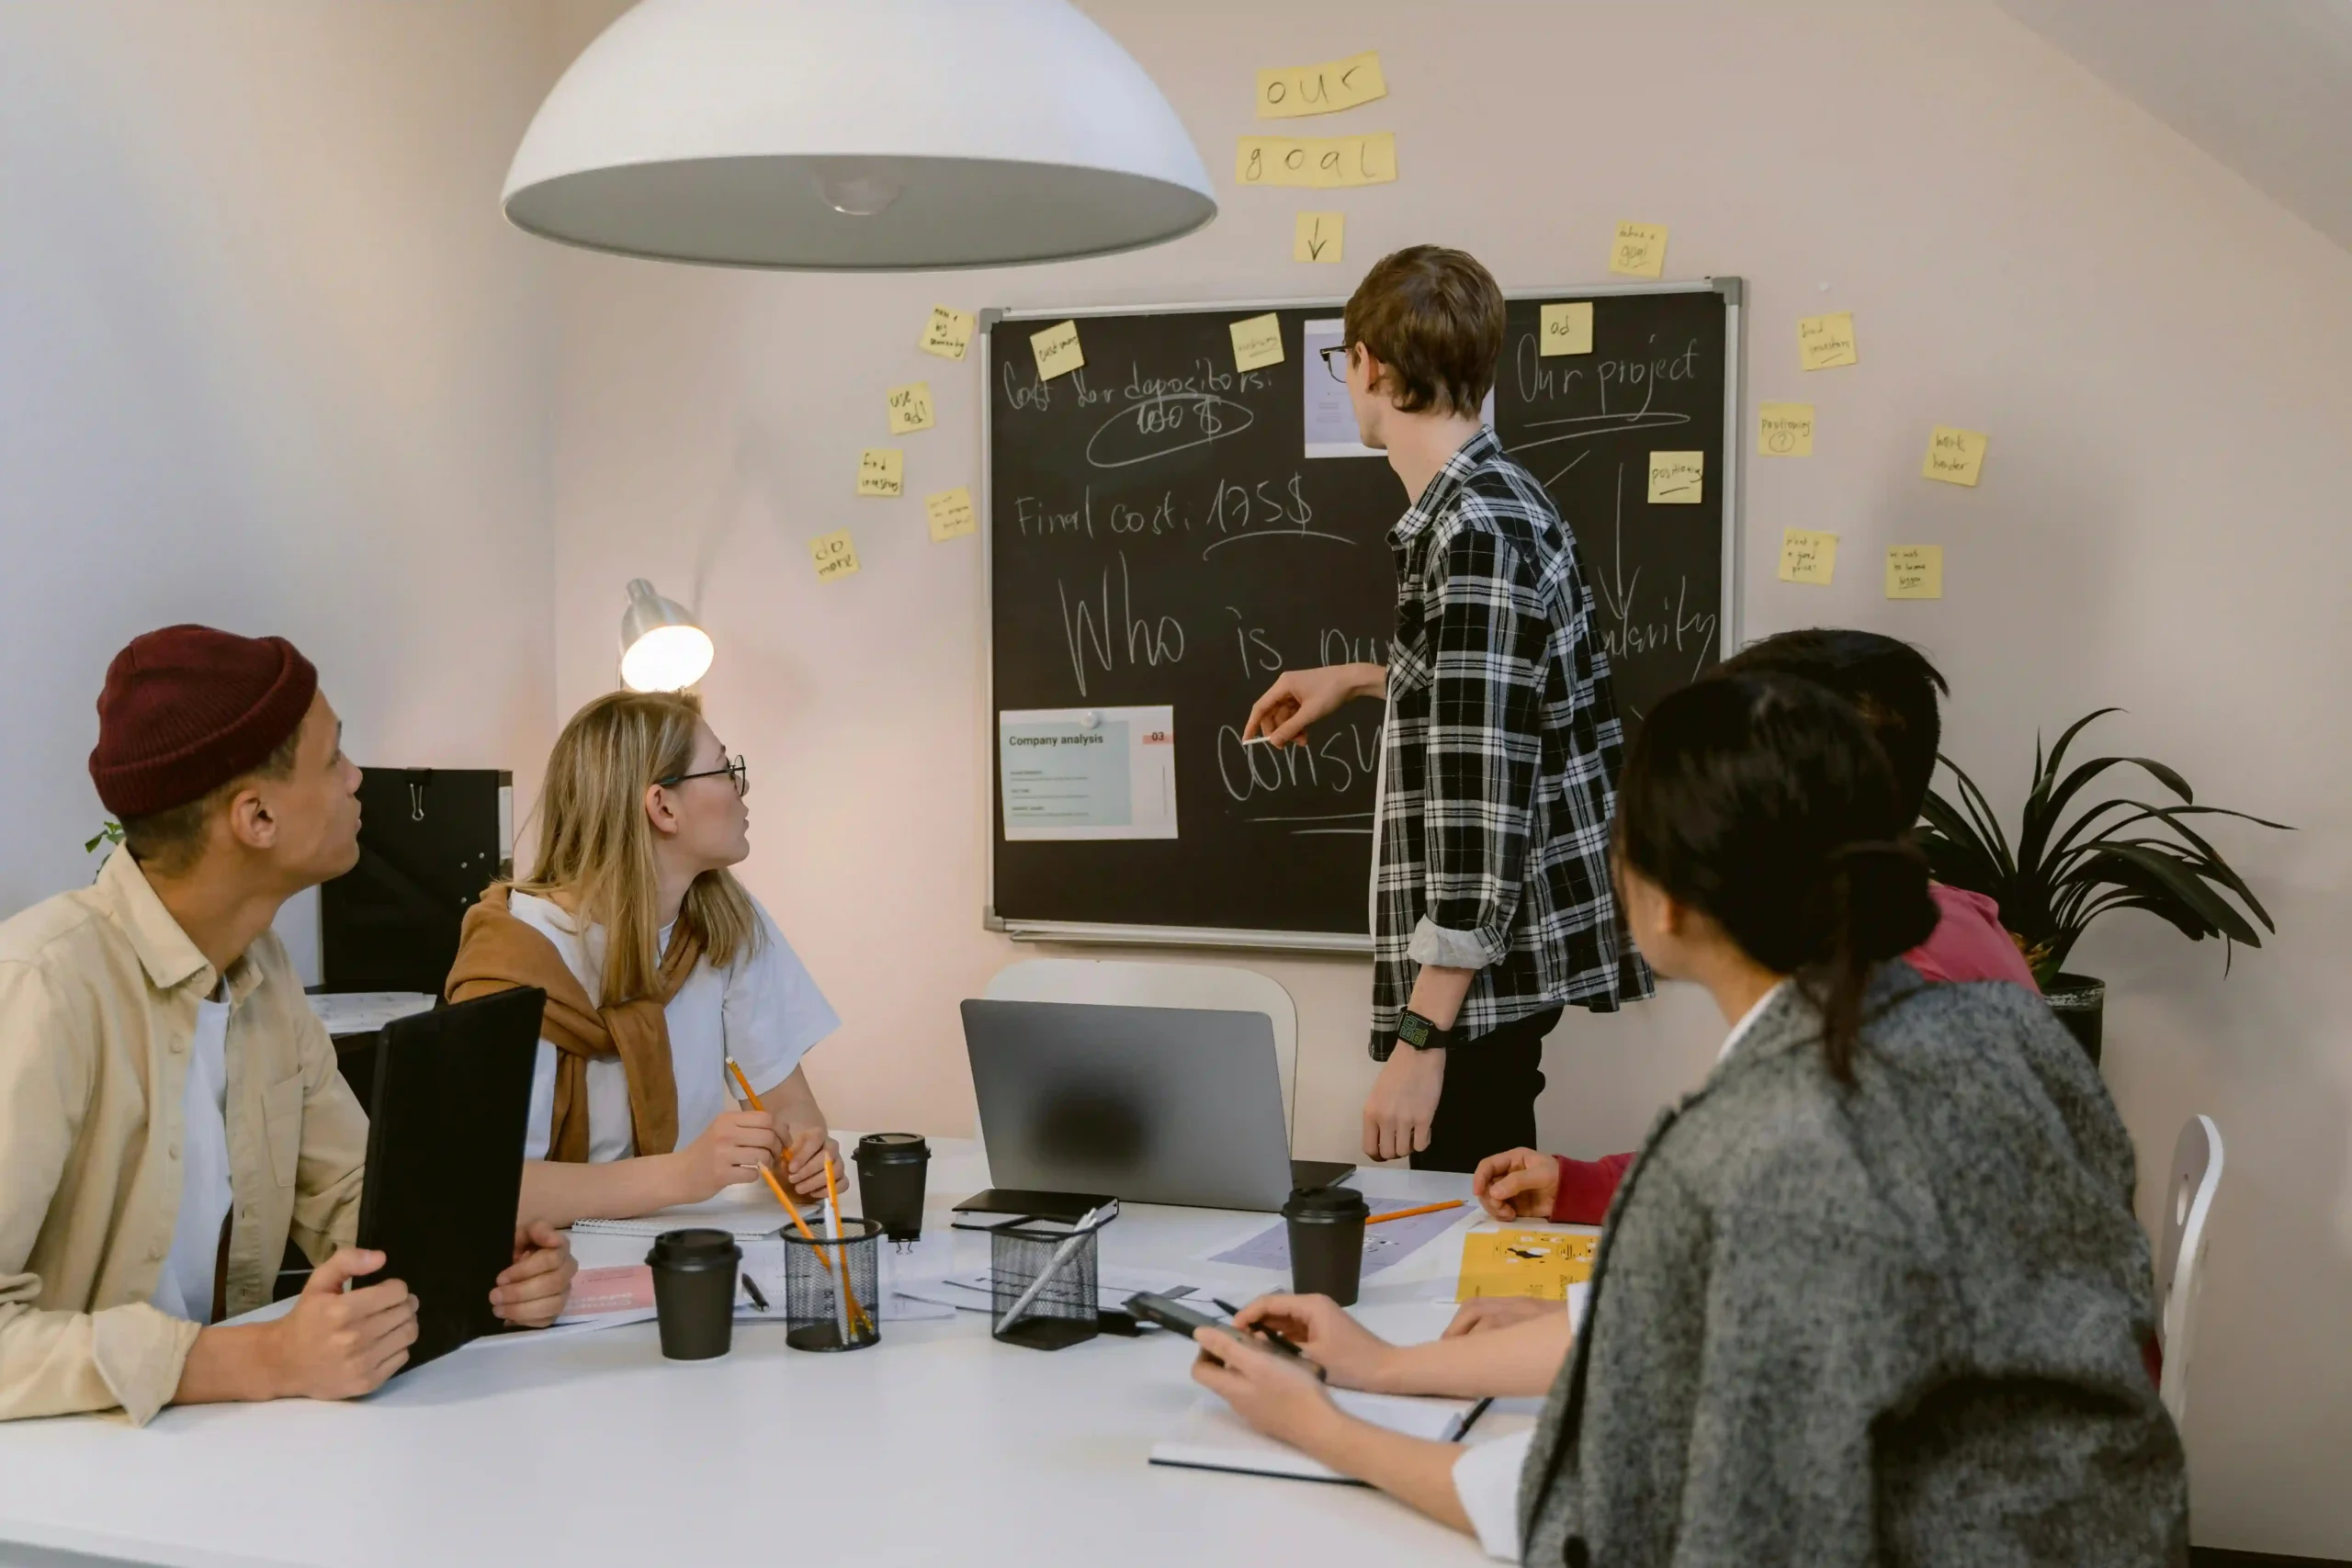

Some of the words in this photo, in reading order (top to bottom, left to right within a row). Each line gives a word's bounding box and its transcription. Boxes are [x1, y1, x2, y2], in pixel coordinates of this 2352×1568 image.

[1266, 65, 1361, 105] our
[1245, 141, 1376, 182] goal
[1618, 243, 1650, 267] goal
[1550, 315, 1570, 336] ad
[1517, 333, 1583, 402] Our
[1597, 333, 1699, 423] project
[1014, 484, 1095, 539] Final
[1057, 550, 1185, 698] Who
[1225, 606, 1283, 680] is
[1009, 736, 1057, 749] Company
[1060, 733, 1104, 748] analysis
[1150, 731, 1165, 741] 03
